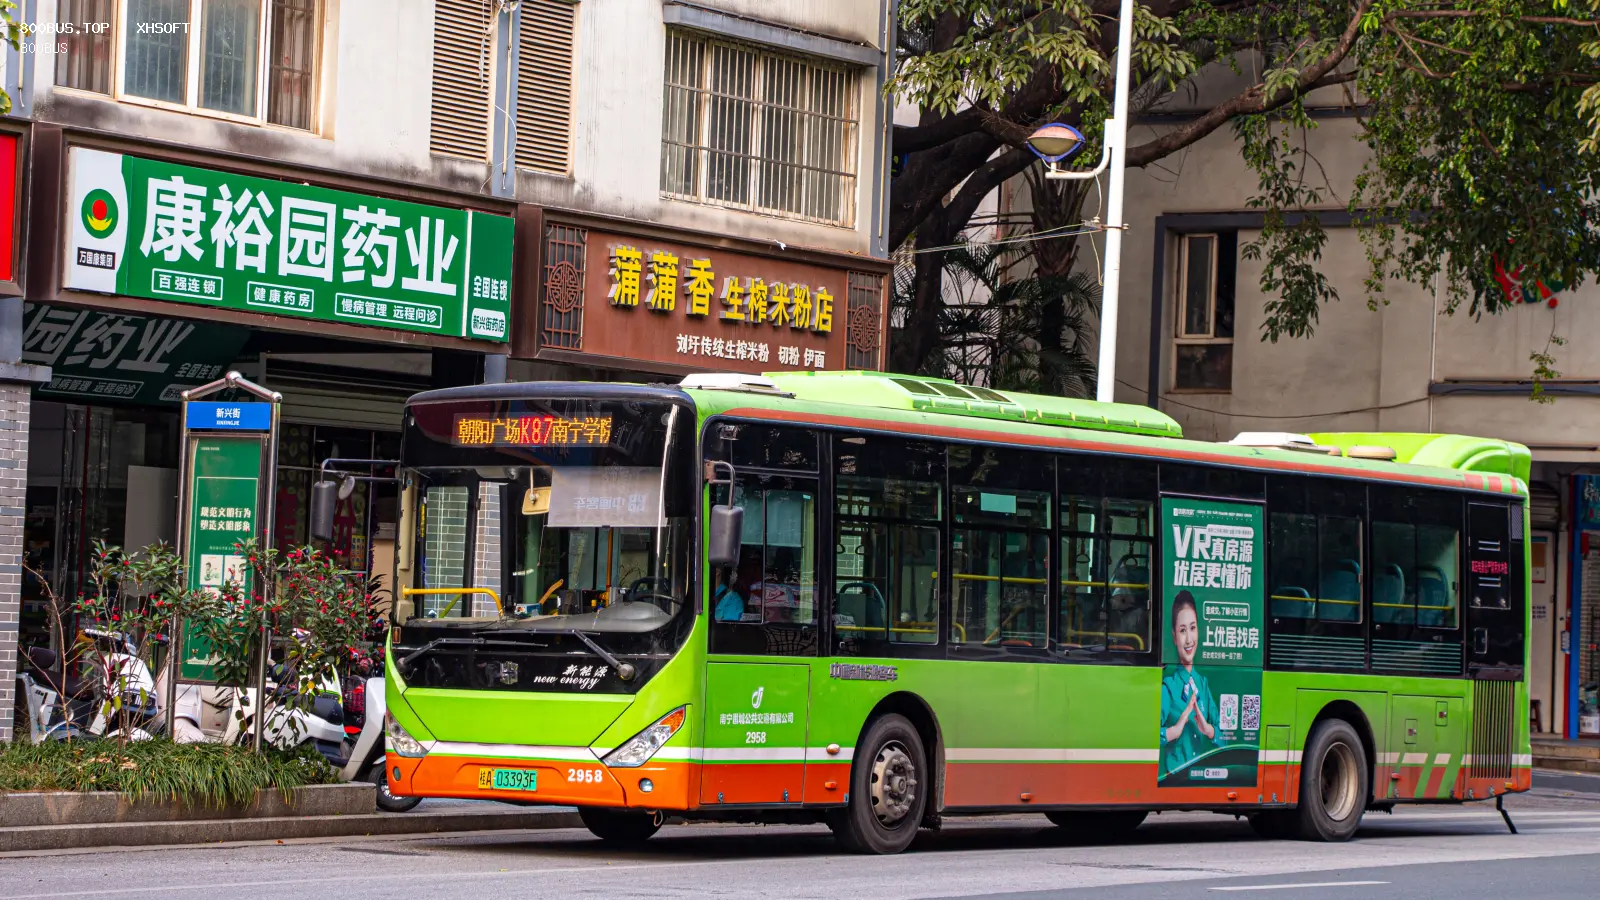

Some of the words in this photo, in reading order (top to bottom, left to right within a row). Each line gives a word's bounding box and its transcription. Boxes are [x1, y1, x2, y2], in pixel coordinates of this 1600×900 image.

[140, 176, 459, 296] 康裕园药业
[79, 250, 113, 268] 万国康集团
[158, 274, 216, 295] 百强连锁
[473, 276, 508, 301] 全国连锁
[608, 245, 715, 316] 蒲蒲香
[719, 276, 834, 332] 生榨米粉店
[253, 287, 310, 308] 健康药房
[341, 299, 387, 317] 慢病管理
[393, 305, 437, 323] 远程问诊
[473, 315, 505, 332] 新兴街药店
[676, 333, 769, 363] 刘圩传统生榨米粉
[778, 345, 800, 366] 切粉
[804, 348, 826, 368] 伊面
[175, 363, 223, 380] 全国连锁
[216, 408, 241, 418] 新兴街
[200, 507, 251, 518] 规范文明行为
[200, 520, 250, 531] 塑造文明形象
[1172, 524, 1253, 563] VR真房源
[1174, 560, 1251, 589] 优居更懂你
[1203, 626, 1259, 648] 上优居找房
[563, 665, 608, 677] 新能源
[534, 675, 557, 683] new
[560, 675, 599, 688] energy
[745, 731, 767, 744] 2958
[479, 770, 492, 786] 桂A
[496, 771, 536, 788] 03393F
[568, 769, 603, 783] 2958
